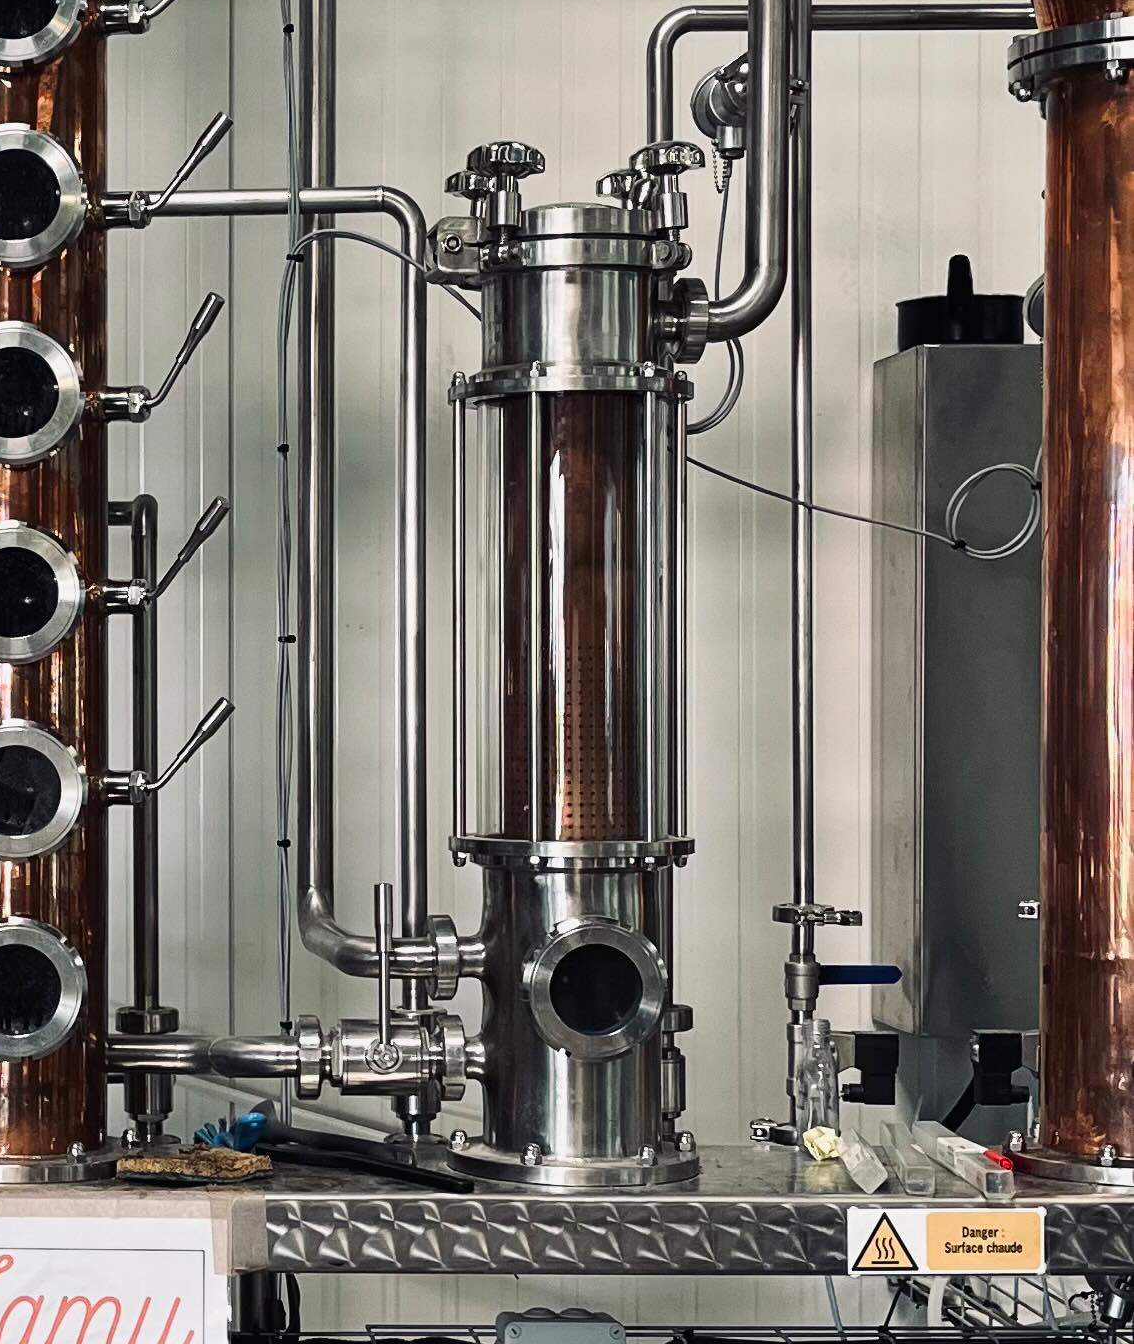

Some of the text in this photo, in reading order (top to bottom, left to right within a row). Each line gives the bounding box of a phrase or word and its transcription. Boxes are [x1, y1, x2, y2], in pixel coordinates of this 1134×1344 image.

[962, 1226, 999, 1240] Danger
[944, 1241, 1023, 1253] Surface chaude
